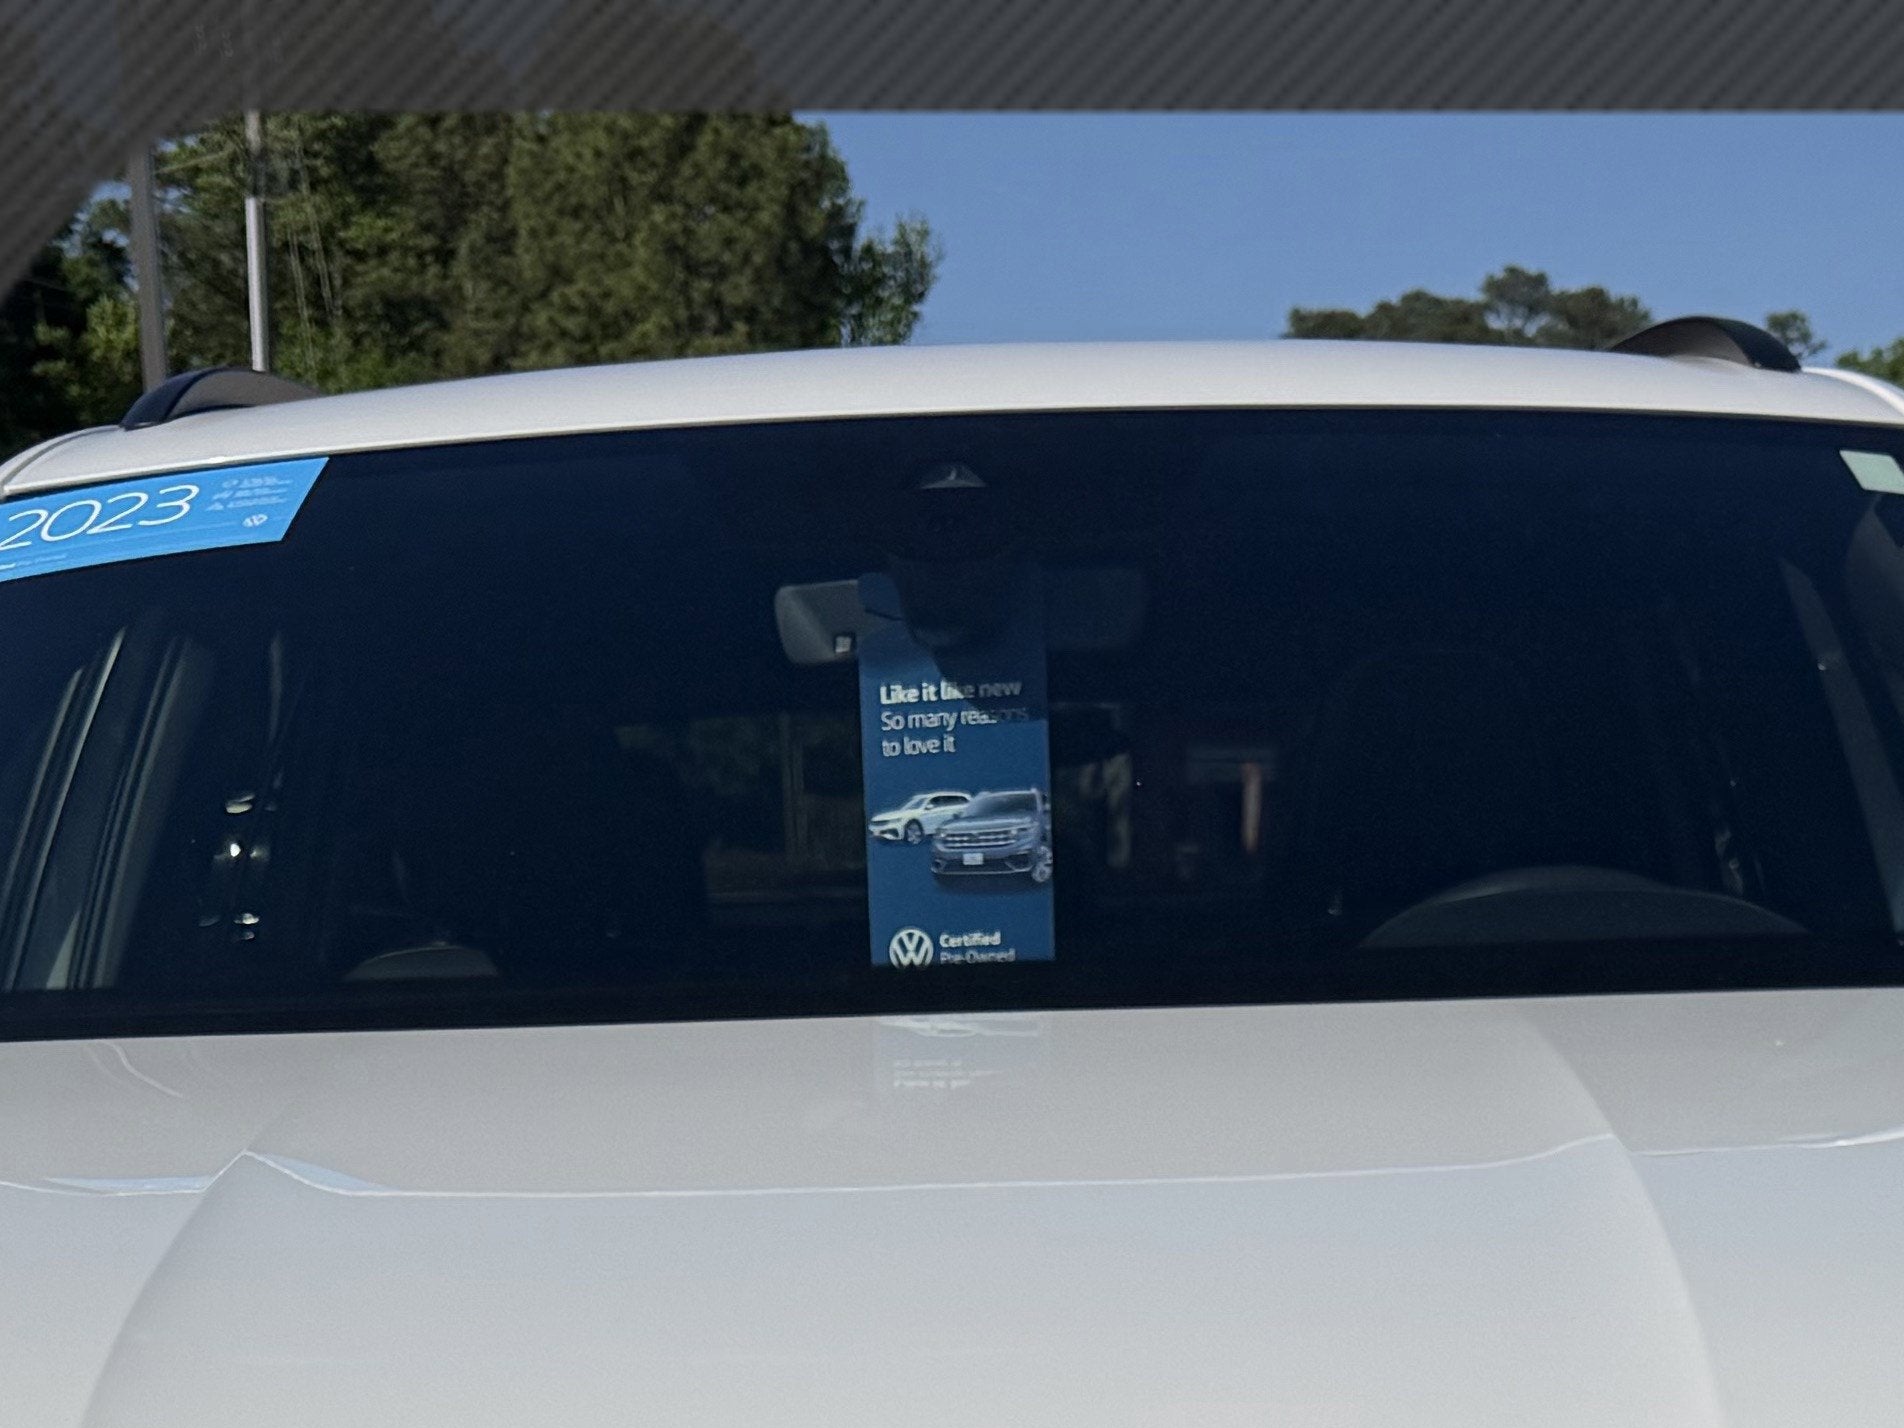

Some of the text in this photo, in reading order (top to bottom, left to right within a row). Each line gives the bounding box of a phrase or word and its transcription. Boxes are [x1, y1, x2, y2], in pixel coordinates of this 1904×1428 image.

[879, 680, 1023, 705] Like it like new
[881, 708, 1030, 732] So many reaons
[881, 734, 956, 757] to love it
[939, 931, 1002, 948] Certified
